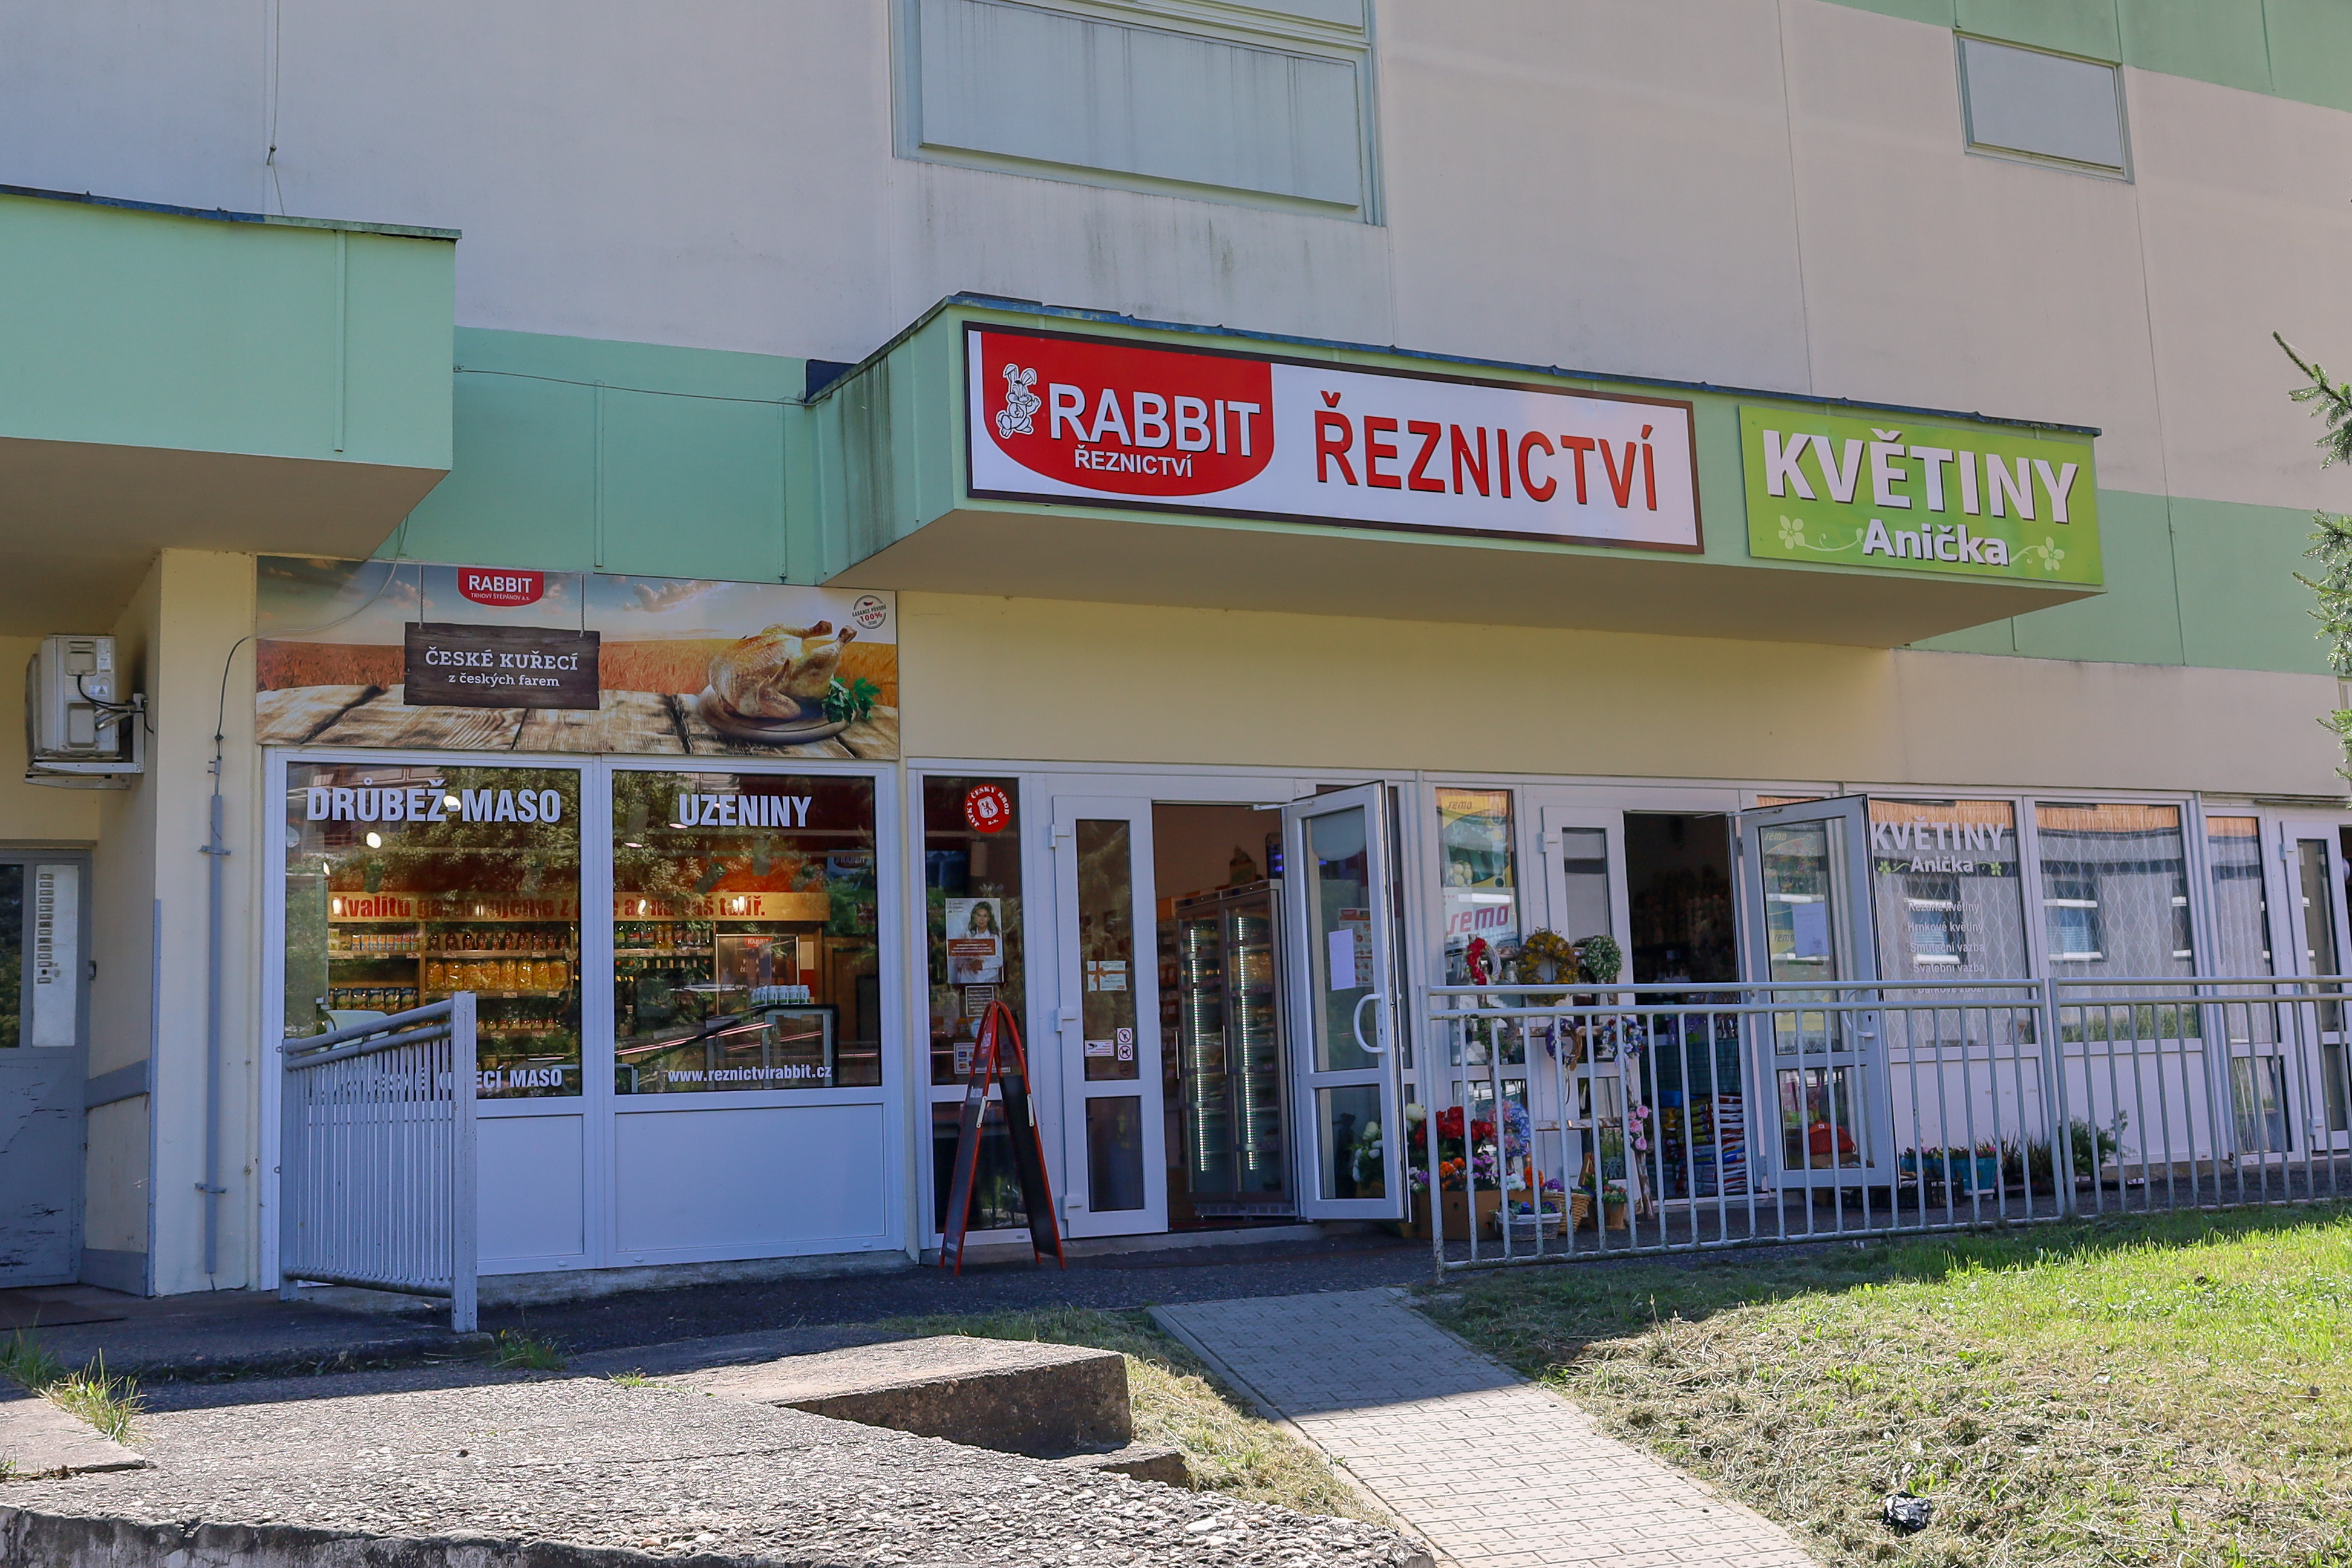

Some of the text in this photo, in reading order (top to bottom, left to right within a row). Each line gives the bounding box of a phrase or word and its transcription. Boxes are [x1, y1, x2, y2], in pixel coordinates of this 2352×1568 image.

[1048, 383, 1261, 457] RABBIT
[1074, 444, 1193, 478] ŘEZNICTVÍ
[1314, 390, 1658, 511] ŘEZNICTVÍ
[1762, 427, 2079, 524] KVĚTINY
[1862, 518, 2010, 567] Anička
[469, 575, 533, 593] RABBIT
[860, 612, 883, 622] 100%
[425, 646, 578, 670] ČESKÉ KUŘECÍ
[448, 672, 560, 687] z českých farem
[679, 794, 812, 828] UZENINY
[998, 791, 1010, 815] BROD
[1446, 800, 1472, 810] semo
[1765, 832, 1788, 841] semo
[1870, 815, 2005, 851] KVĚTINY
[1910, 855, 1974, 873] Anička
[719, 895, 766, 916] tíř.
[1446, 904, 1509, 935] semo
[1957, 941, 1985, 953] vazba
[1957, 962, 1985, 973] vazba
[509, 1068, 563, 1089] MASO
[667, 1064, 832, 1082] www.reznictvirabbit.cz
